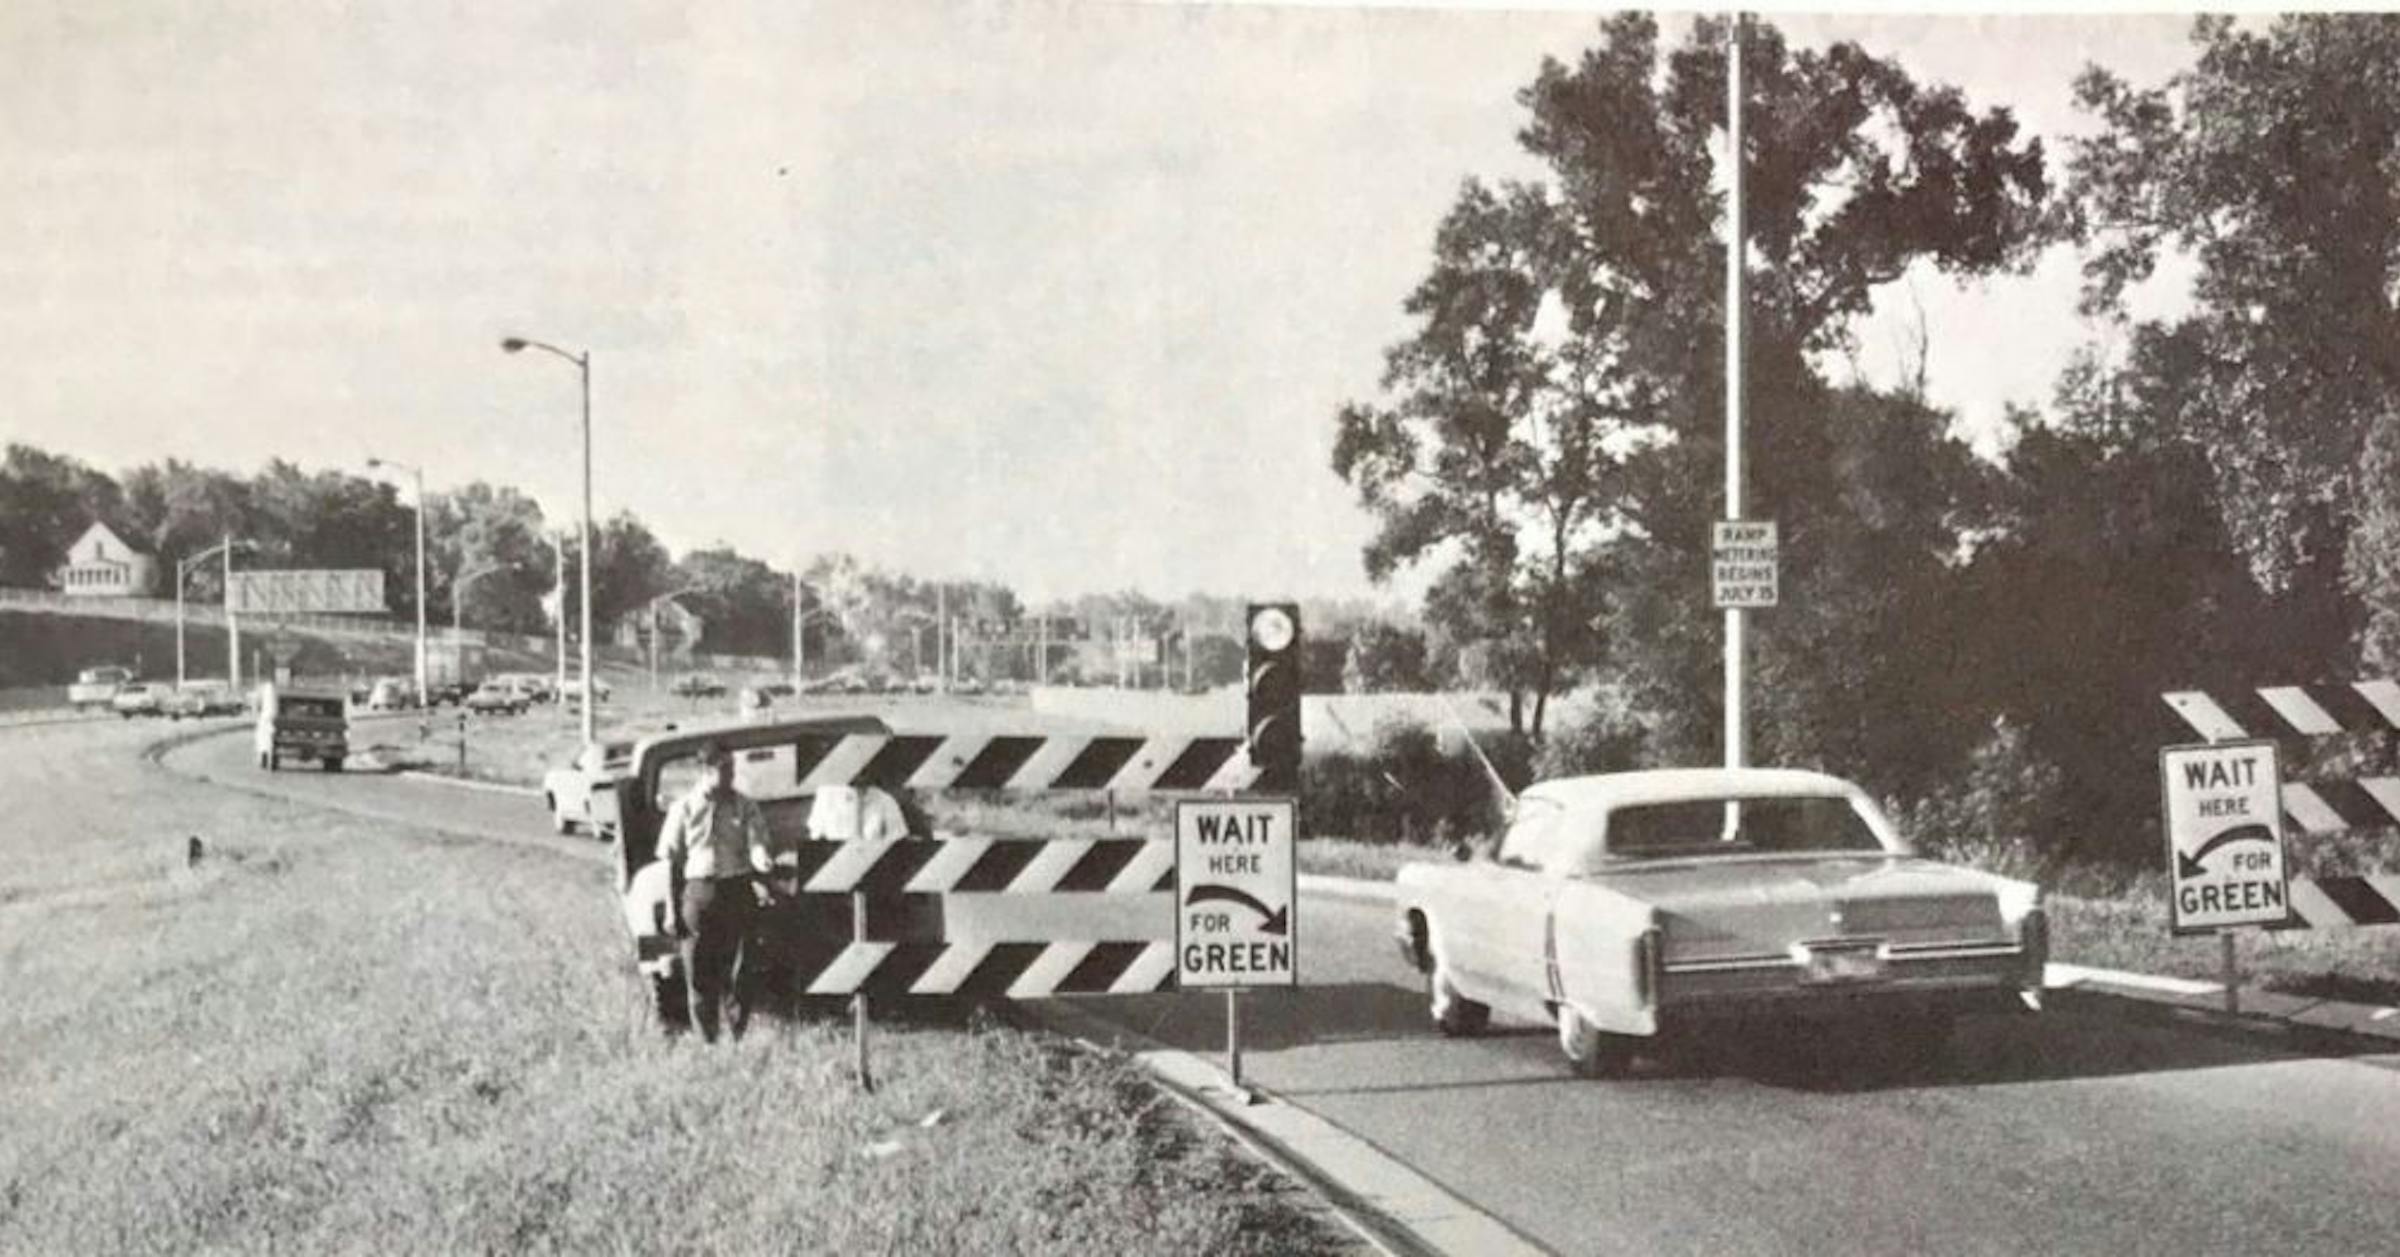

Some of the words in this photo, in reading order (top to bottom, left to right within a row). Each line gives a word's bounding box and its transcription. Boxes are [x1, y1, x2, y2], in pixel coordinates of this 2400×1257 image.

[1723, 529, 1767, 541] RAMP
[1719, 566, 1772, 581] BEGINS
[2184, 759, 2256, 789] WAIT
[2199, 797, 2250, 817] HERE
[1197, 815, 1273, 844] WAIT
[1209, 855, 1261, 874] HERE
[2233, 852, 2271, 871] FOR
[2181, 881, 2282, 914] GREEN
[1191, 914, 1230, 932] FOR
[1184, 943, 1289, 973] GREEN
